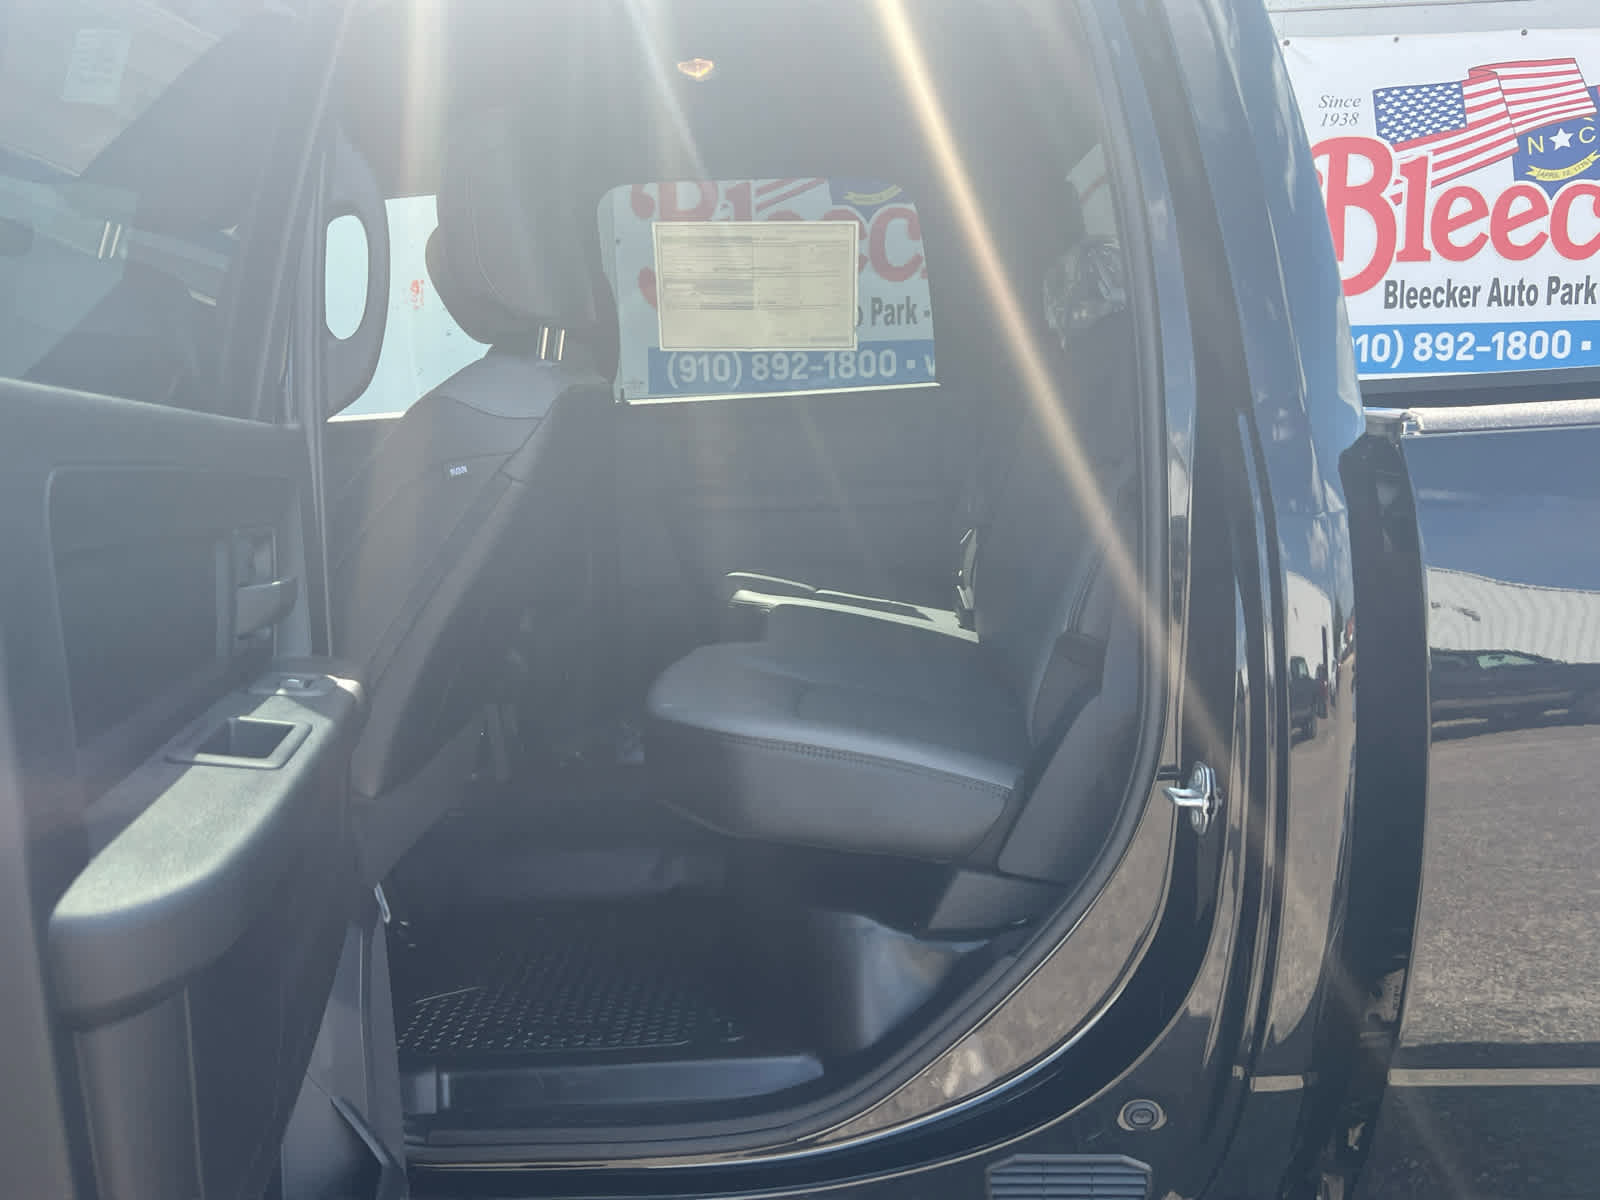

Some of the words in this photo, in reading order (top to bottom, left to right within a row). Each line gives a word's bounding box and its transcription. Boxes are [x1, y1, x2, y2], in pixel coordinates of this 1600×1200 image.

[1318, 95, 1361, 108] Since
[1321, 112, 1359, 127] 1938
[1527, 135, 1544, 155] N
[1578, 126, 1596, 144] C
[1384, 279, 1481, 310] Bleecker
[1487, 277, 1539, 307] Auto
[1547, 275, 1597, 306] Park
[871, 295, 918, 328] Park
[1413, 330, 1572, 363] 892-1800
[667, 351, 742, 389] (910)
[751, 349, 897, 381] 892-1800
